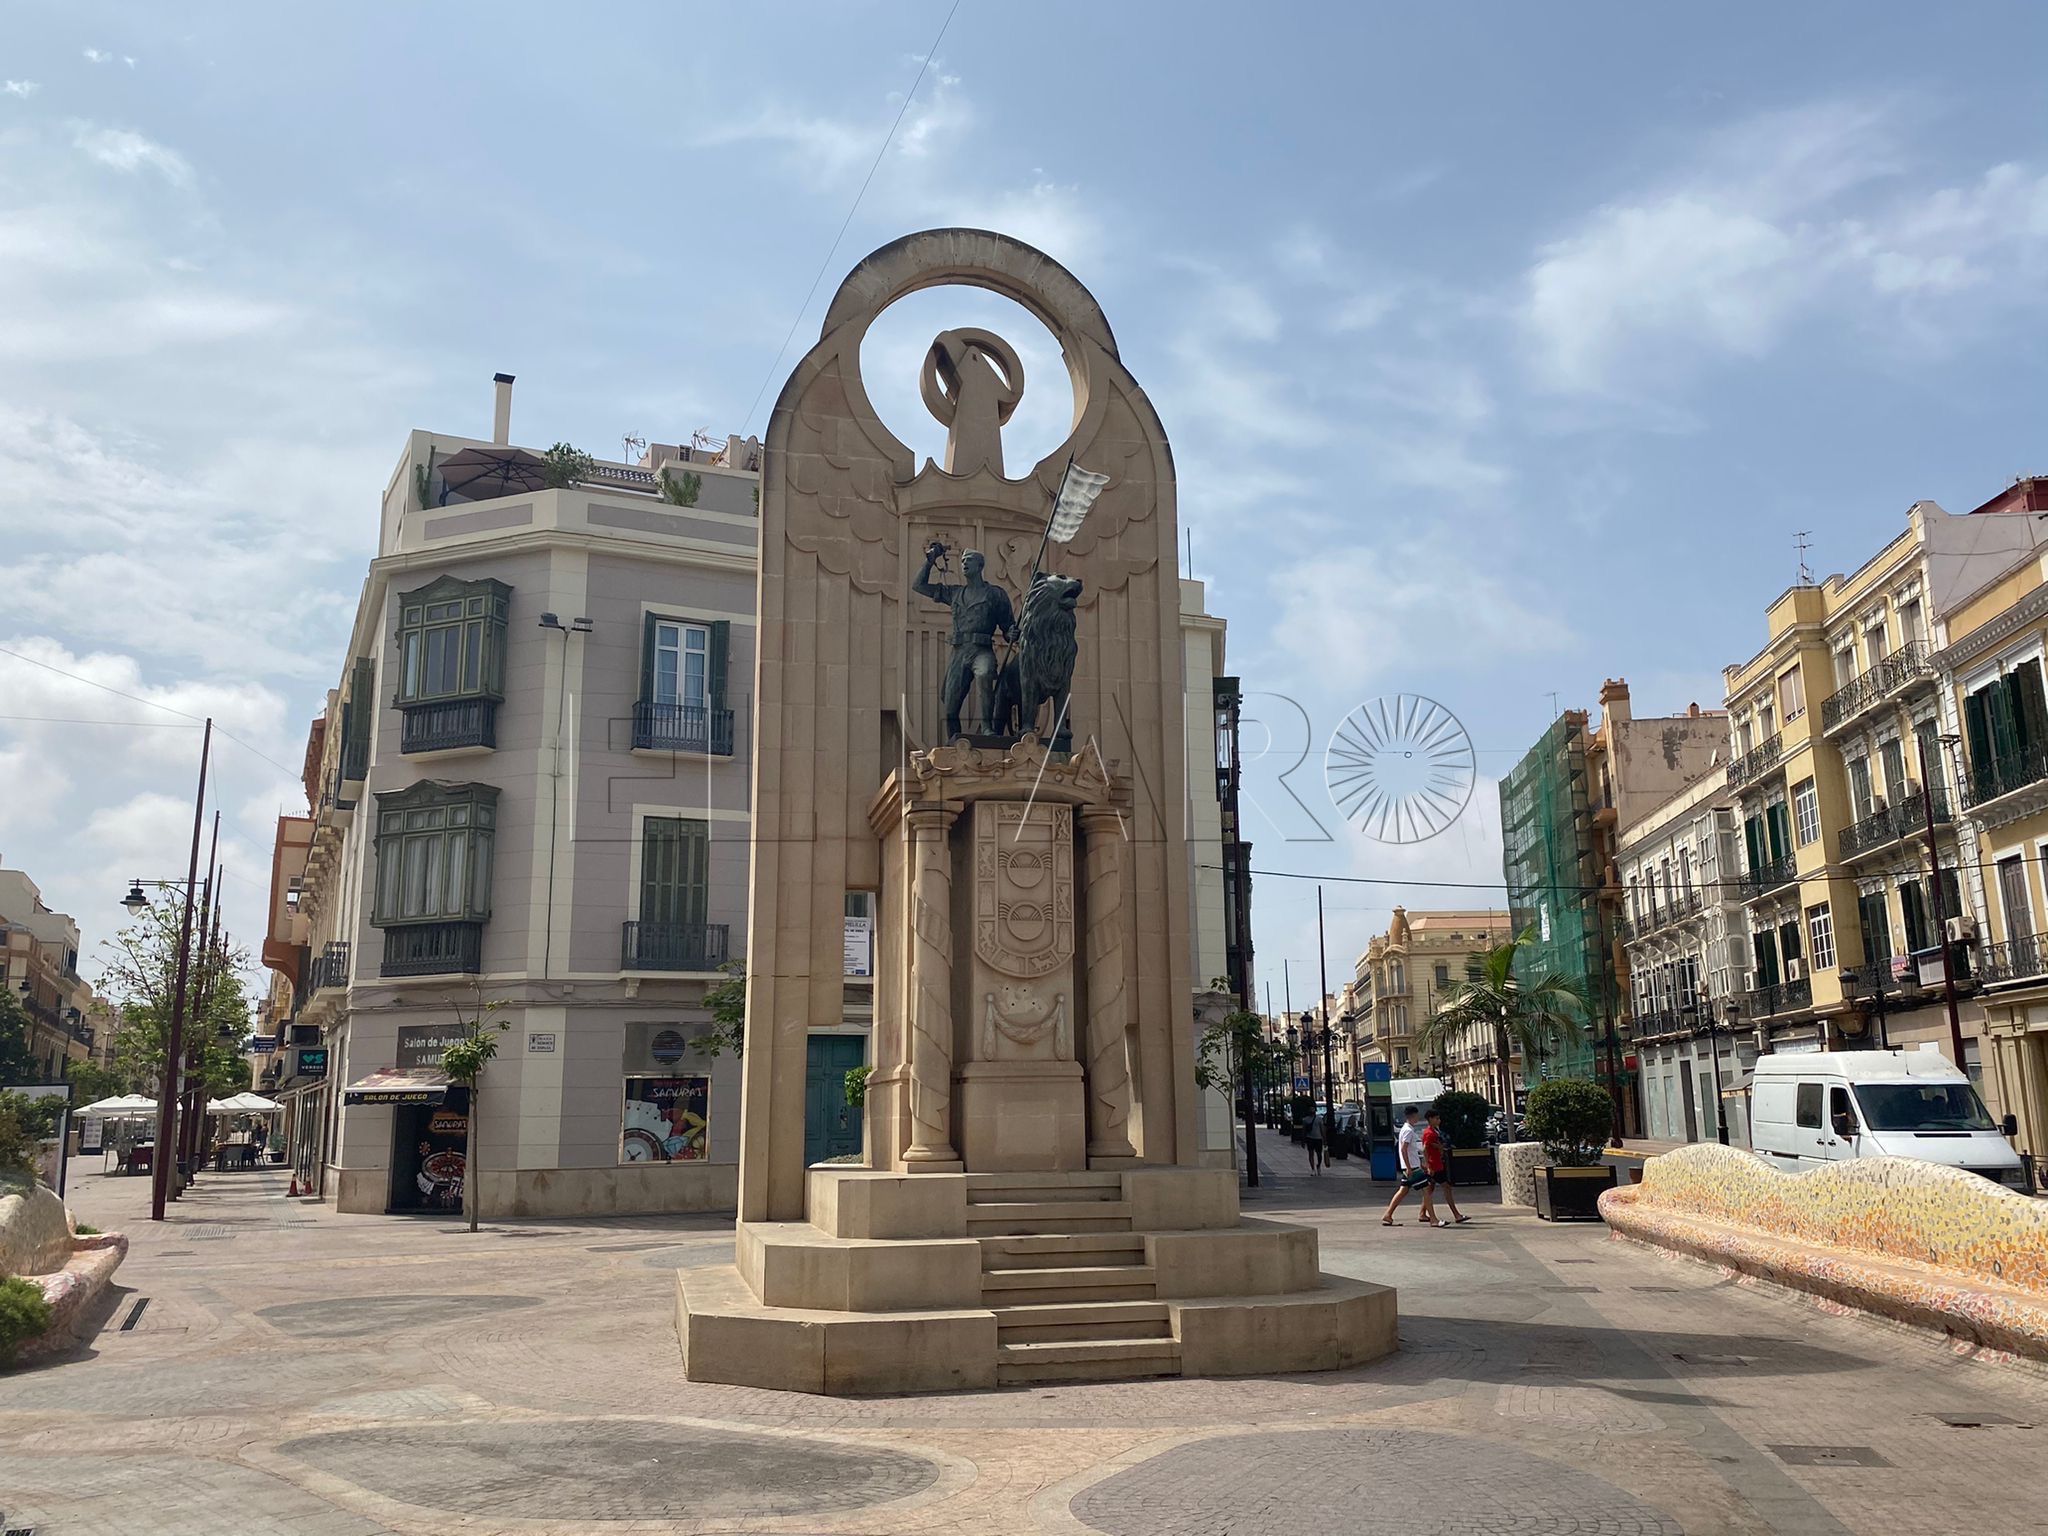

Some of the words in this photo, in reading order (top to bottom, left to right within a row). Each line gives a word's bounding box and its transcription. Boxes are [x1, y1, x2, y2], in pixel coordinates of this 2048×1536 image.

[404, 1037, 426, 1048] Salón
[427, 1036, 438, 1047] de
[652, 1087, 703, 1098] SAMURAI
